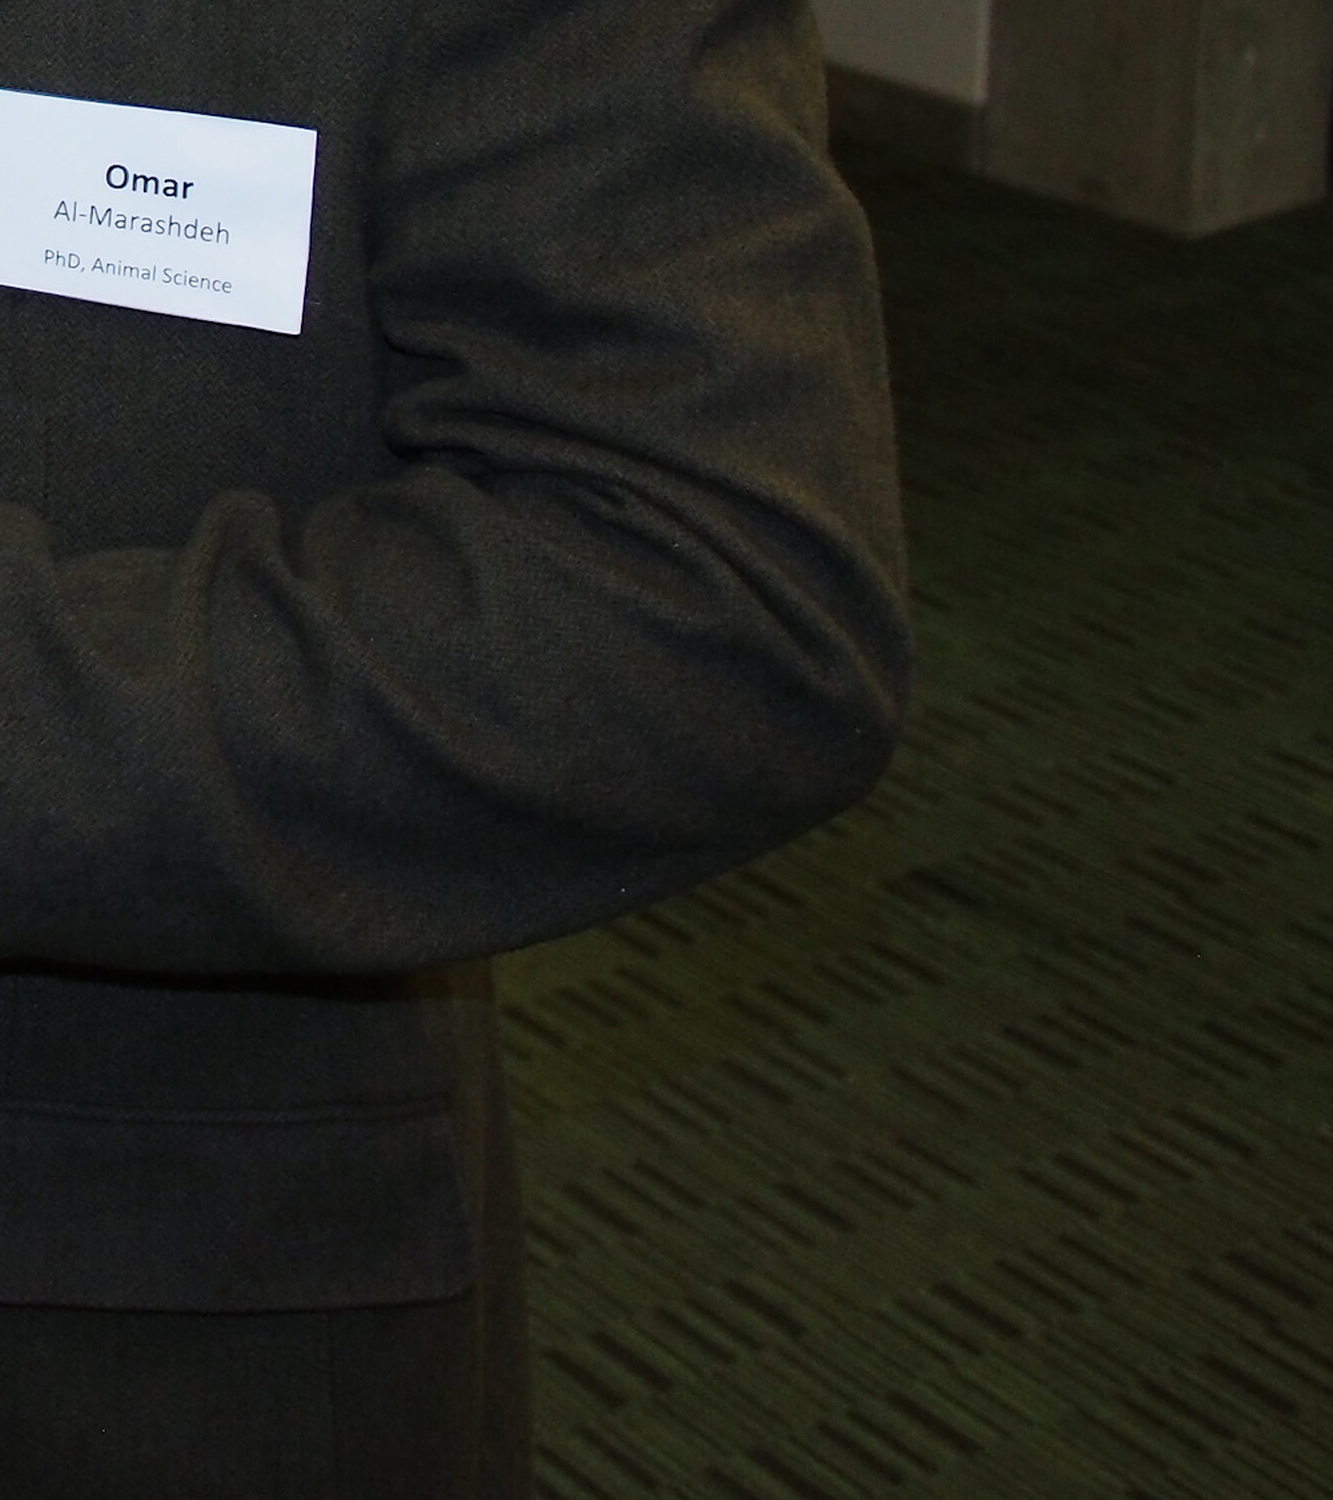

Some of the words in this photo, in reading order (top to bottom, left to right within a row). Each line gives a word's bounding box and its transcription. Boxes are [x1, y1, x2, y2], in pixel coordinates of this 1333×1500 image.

[105, 163, 195, 200] Omar
[53, 199, 231, 245] Al-Marashdeh
[44, 248, 86, 274] PhD,
[91, 255, 158, 281] Animal
[162, 266, 233, 294] Science
